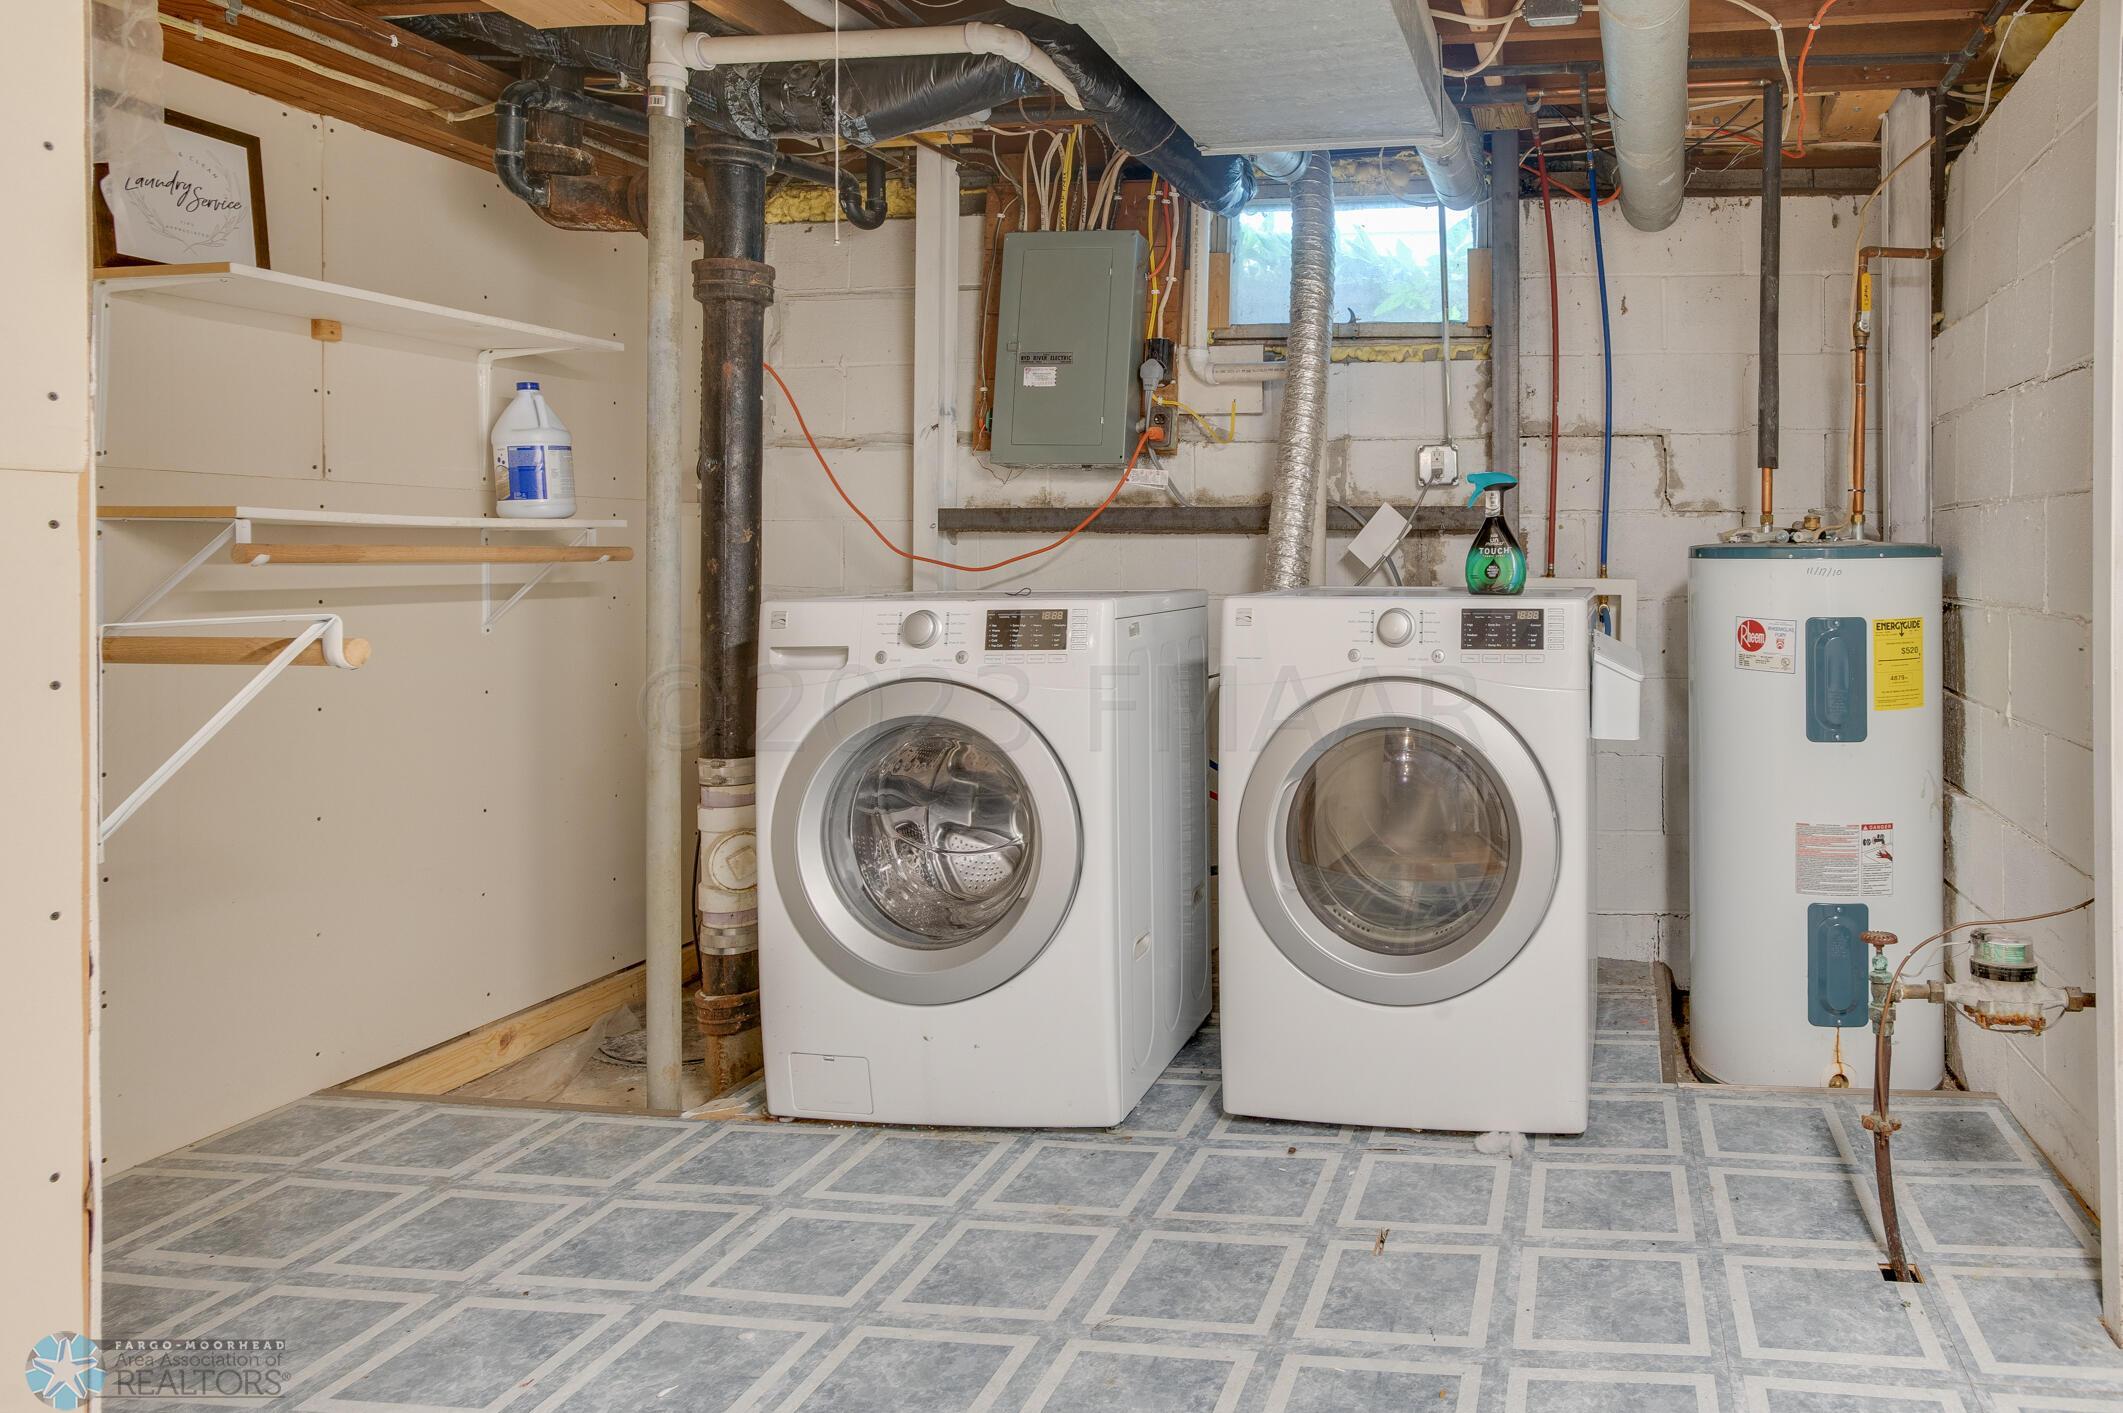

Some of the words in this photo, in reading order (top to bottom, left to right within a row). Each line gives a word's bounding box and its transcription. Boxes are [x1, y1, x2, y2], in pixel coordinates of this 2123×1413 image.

[124, 170, 192, 206] Laundry
[185, 186, 242, 213] Service
[1479, 547, 1511, 555] TOUCH
[1740, 620, 1765, 648] Rheem
